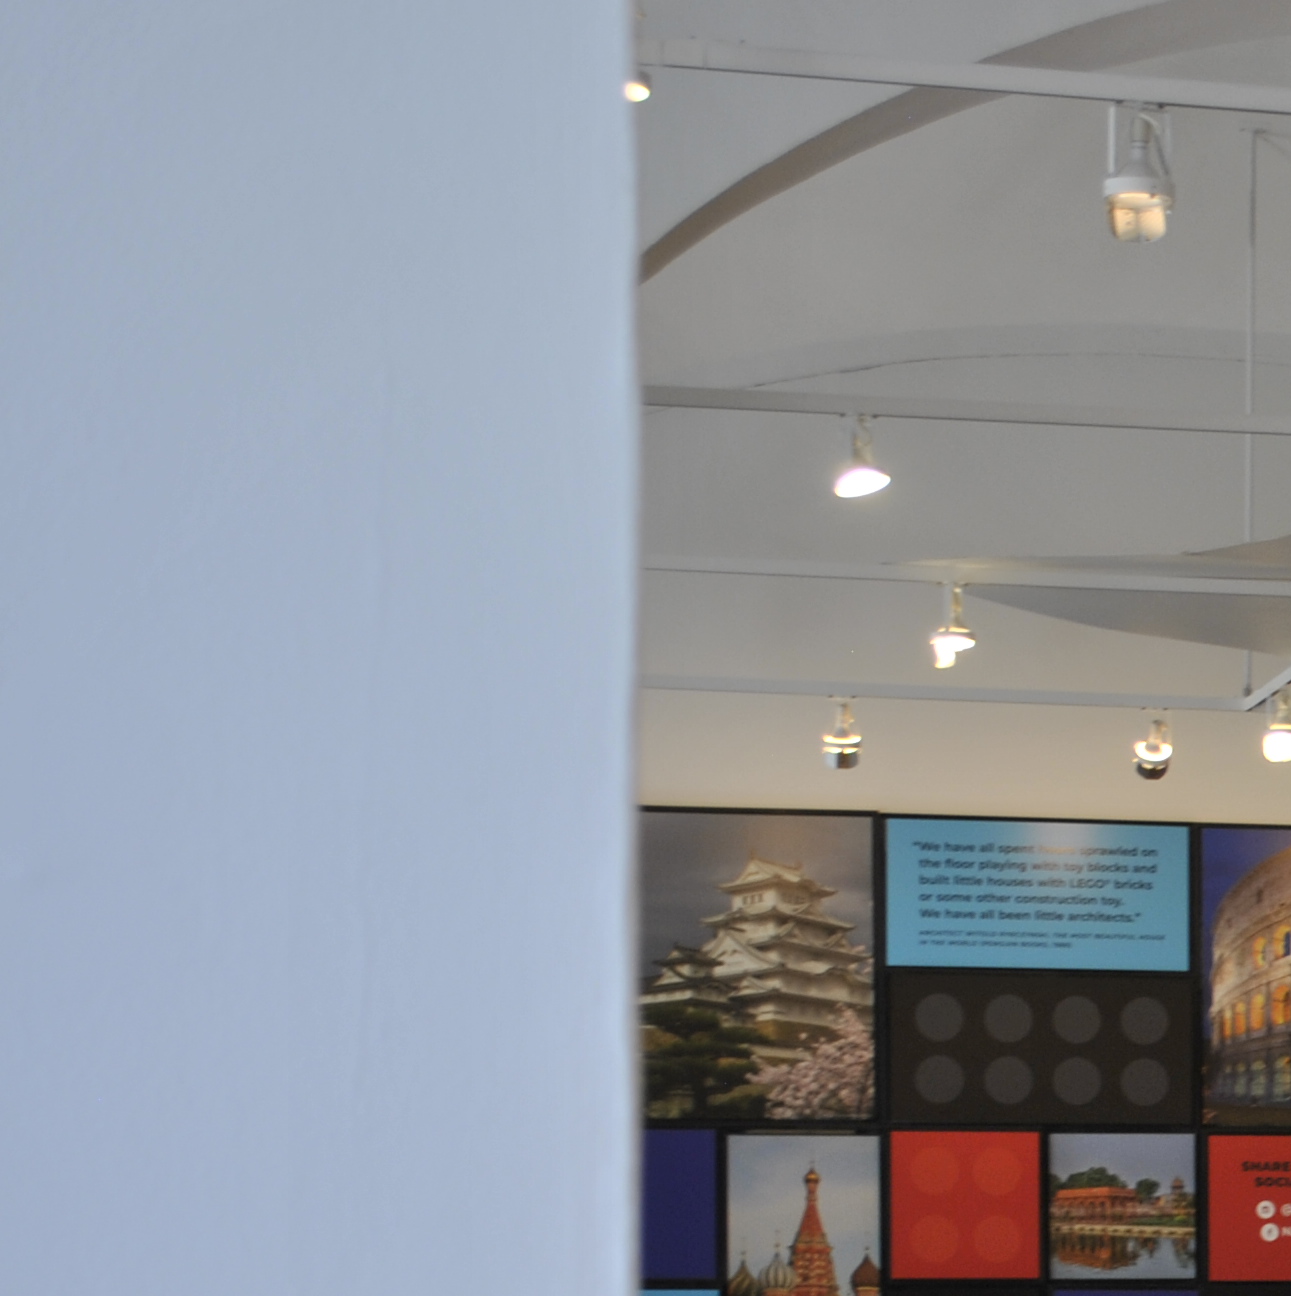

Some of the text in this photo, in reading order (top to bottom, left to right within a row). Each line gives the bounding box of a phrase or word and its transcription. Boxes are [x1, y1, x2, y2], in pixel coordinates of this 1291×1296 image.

[919, 858, 941, 869] the
[978, 859, 1026, 873] playing
[953, 876, 983, 886] little
[986, 877, 1034, 887] houses
[919, 894, 933, 902] or
[936, 894, 972, 903] some
[976, 893, 1011, 903] other
[919, 908, 941, 918] We
[944, 908, 976, 919] have
[999, 909, 1031, 920] been
[1242, 1161, 1291, 1173] SHARE
